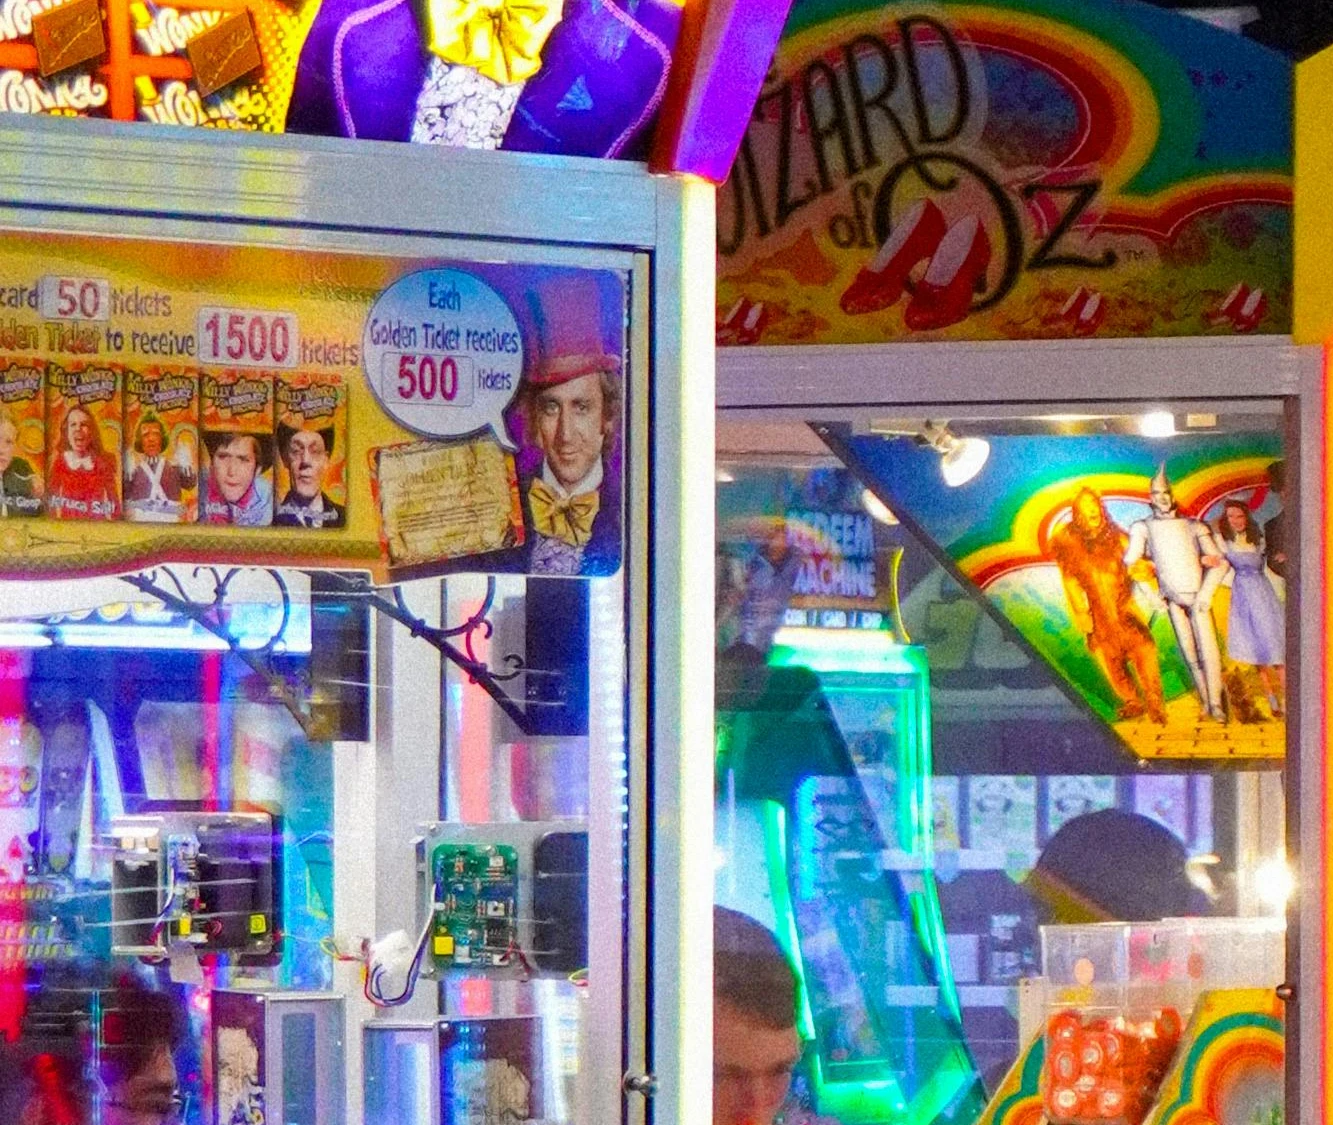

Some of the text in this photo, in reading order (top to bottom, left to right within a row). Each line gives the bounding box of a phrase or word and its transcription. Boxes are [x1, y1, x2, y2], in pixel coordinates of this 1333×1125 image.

[828, 180, 873, 250] of
[58, 280, 100, 318] 50
[112, 286, 173, 317] tickets
[428, 281, 461, 312] Each
[104, 331, 124, 352] to
[132, 333, 197, 357] receive
[204, 313, 290, 363] 1500
[301, 339, 359, 367] tickets
[370, 319, 518, 355] Golden Ticket receives
[398, 355, 511, 401] 500 tickets
